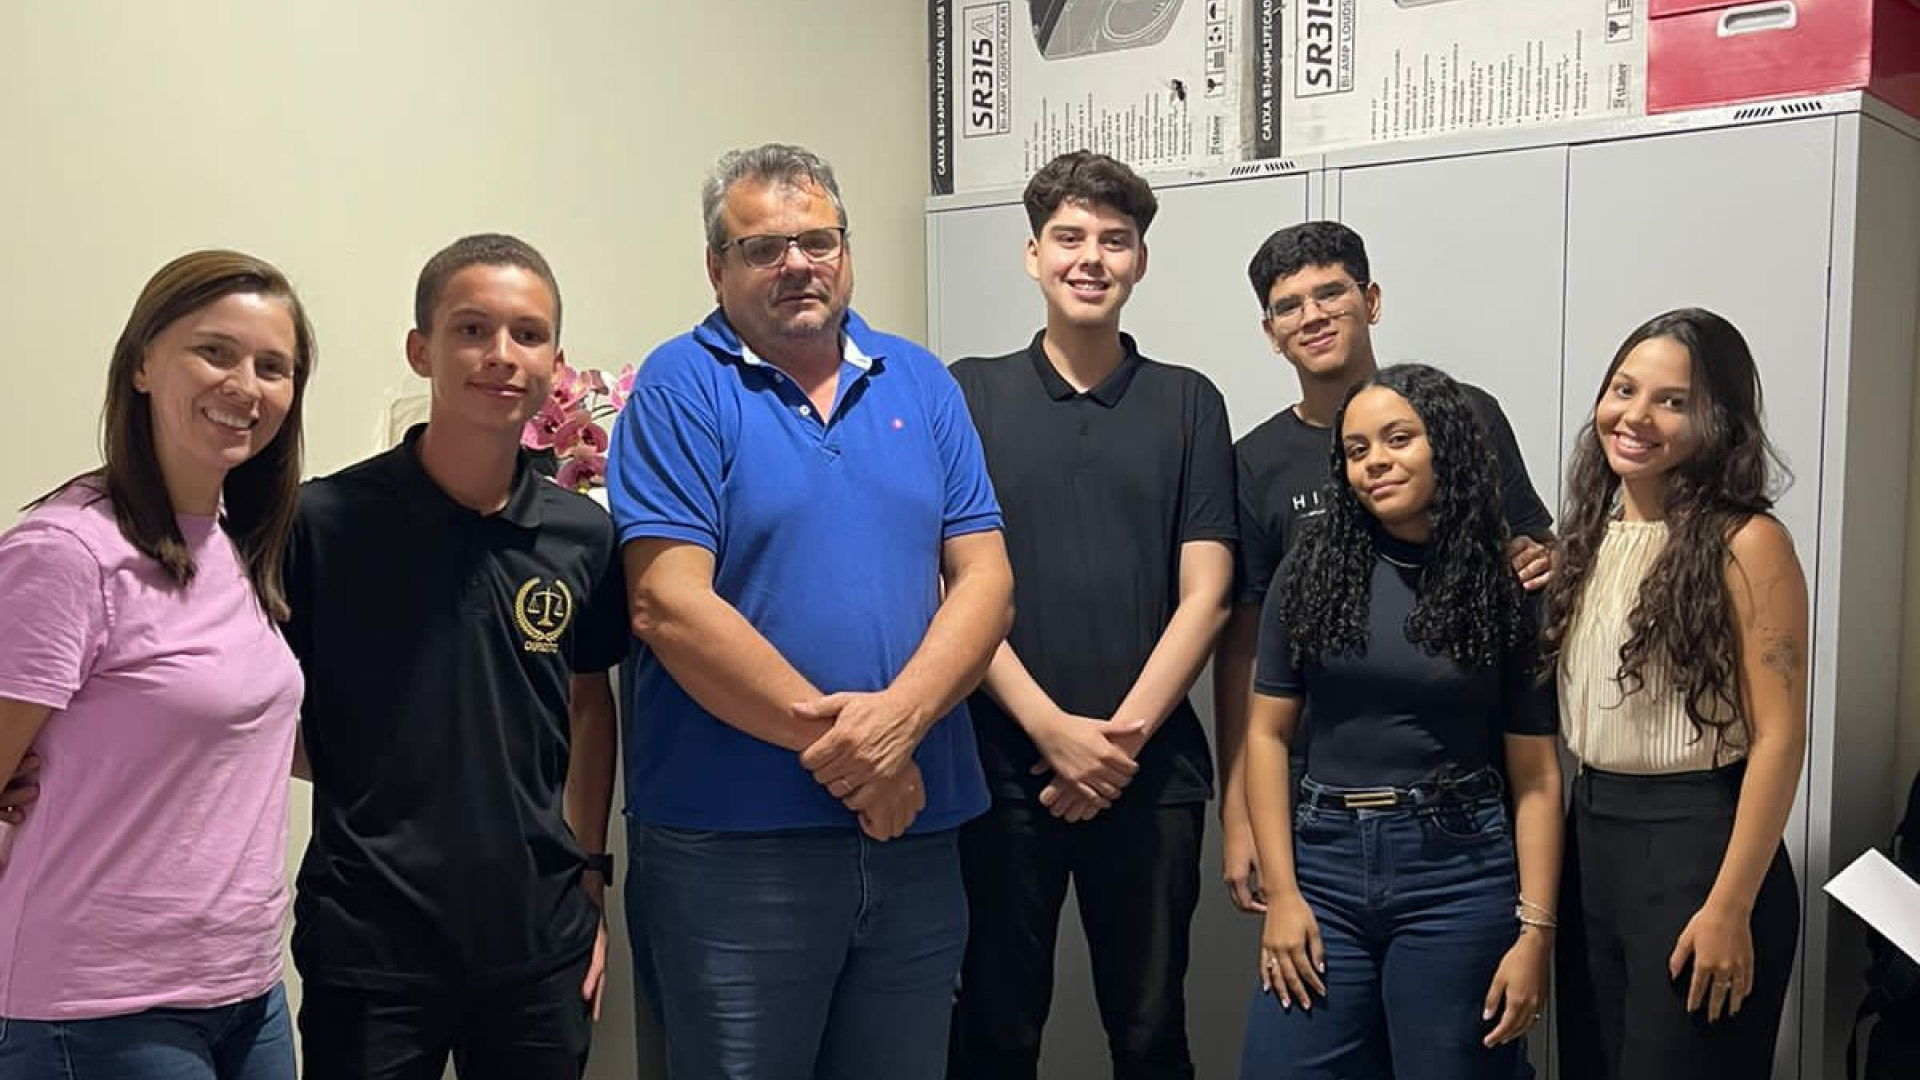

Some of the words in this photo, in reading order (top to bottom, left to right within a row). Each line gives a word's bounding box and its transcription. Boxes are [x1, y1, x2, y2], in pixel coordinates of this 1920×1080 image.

[937, 7, 945, 38] DUAS
[937, 40, 945, 136] BI-AMPLIFICADA
[1262, 100, 1272, 141] CAIXA
[937, 140, 945, 175] CAIXA
